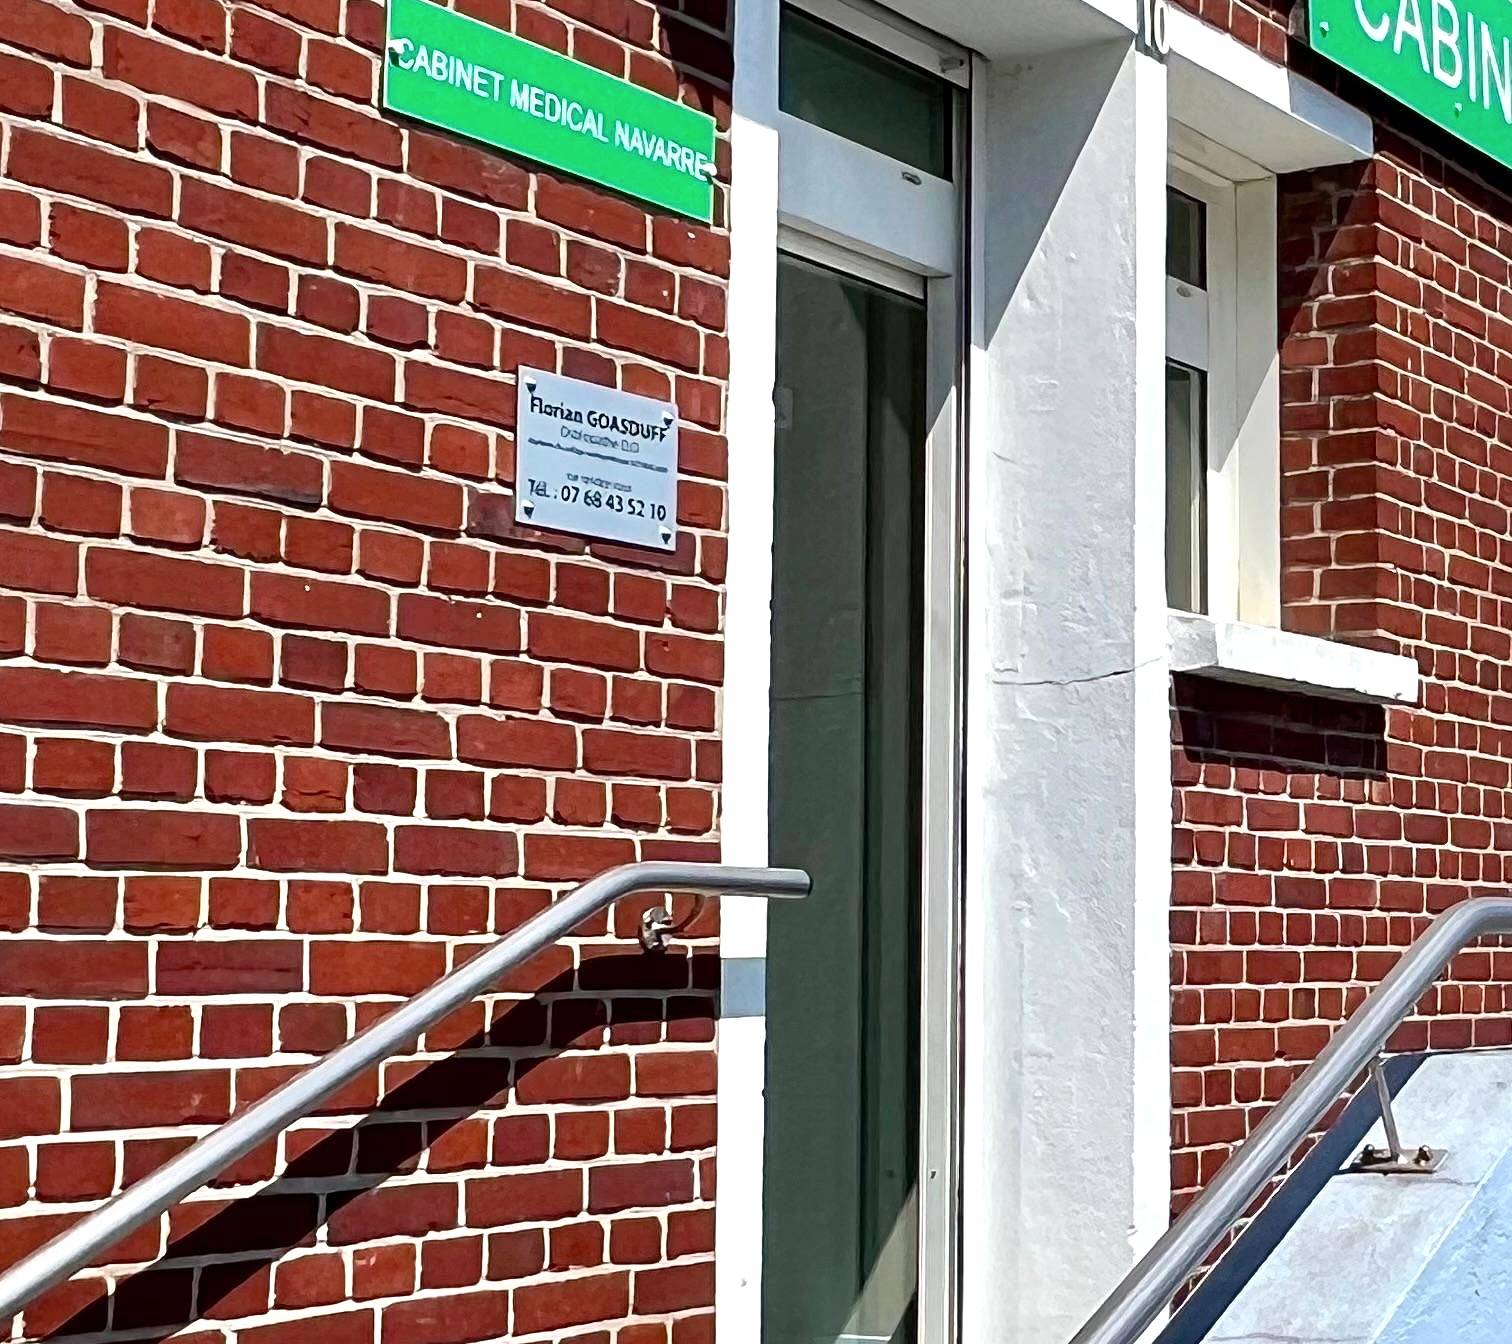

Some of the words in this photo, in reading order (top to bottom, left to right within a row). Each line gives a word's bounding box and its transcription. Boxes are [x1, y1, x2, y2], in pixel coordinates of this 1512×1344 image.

[398, 38, 504, 102] CABINET
[510, 78, 609, 144] MEDICAL
[614, 119, 710, 182] NAVARRE
[530, 396, 583, 424] Florian
[587, 410, 668, 443] GOASDUFF
[561, 485, 580, 503] 07
[584, 490, 602, 508] 68
[606, 494, 623, 513] 43
[628, 499, 645, 517] 52
[650, 504, 667, 521] 10
